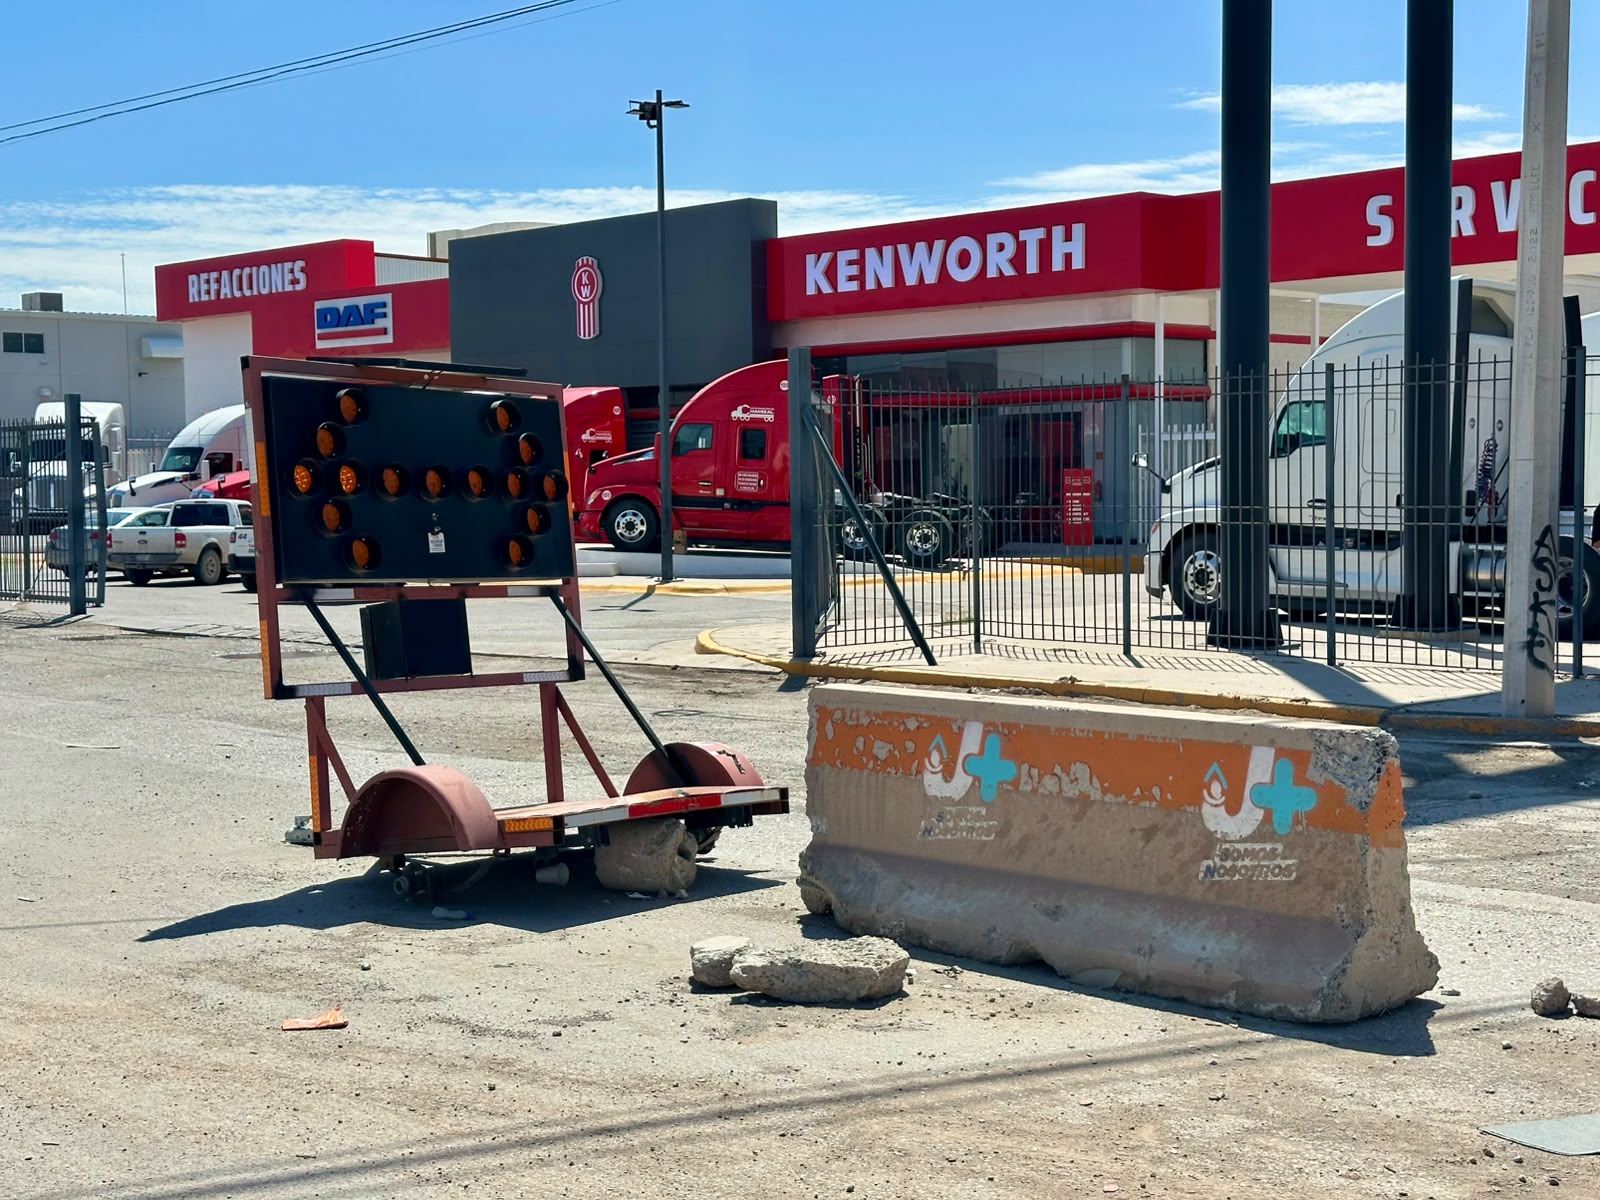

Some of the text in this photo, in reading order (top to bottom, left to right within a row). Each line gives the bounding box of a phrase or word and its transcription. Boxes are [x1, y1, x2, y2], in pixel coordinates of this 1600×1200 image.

[1366, 170, 1597, 247] SRVC
[805, 223, 1086, 295] KENWORTH
[1527, 227, 1538, 263] 2022
[188, 260, 306, 303] REFACCIONES
[316, 302, 387, 329] DAF
[1199, 860, 1298, 881] NOSOTROS
[1216, 843, 1284, 862] SOMOS
